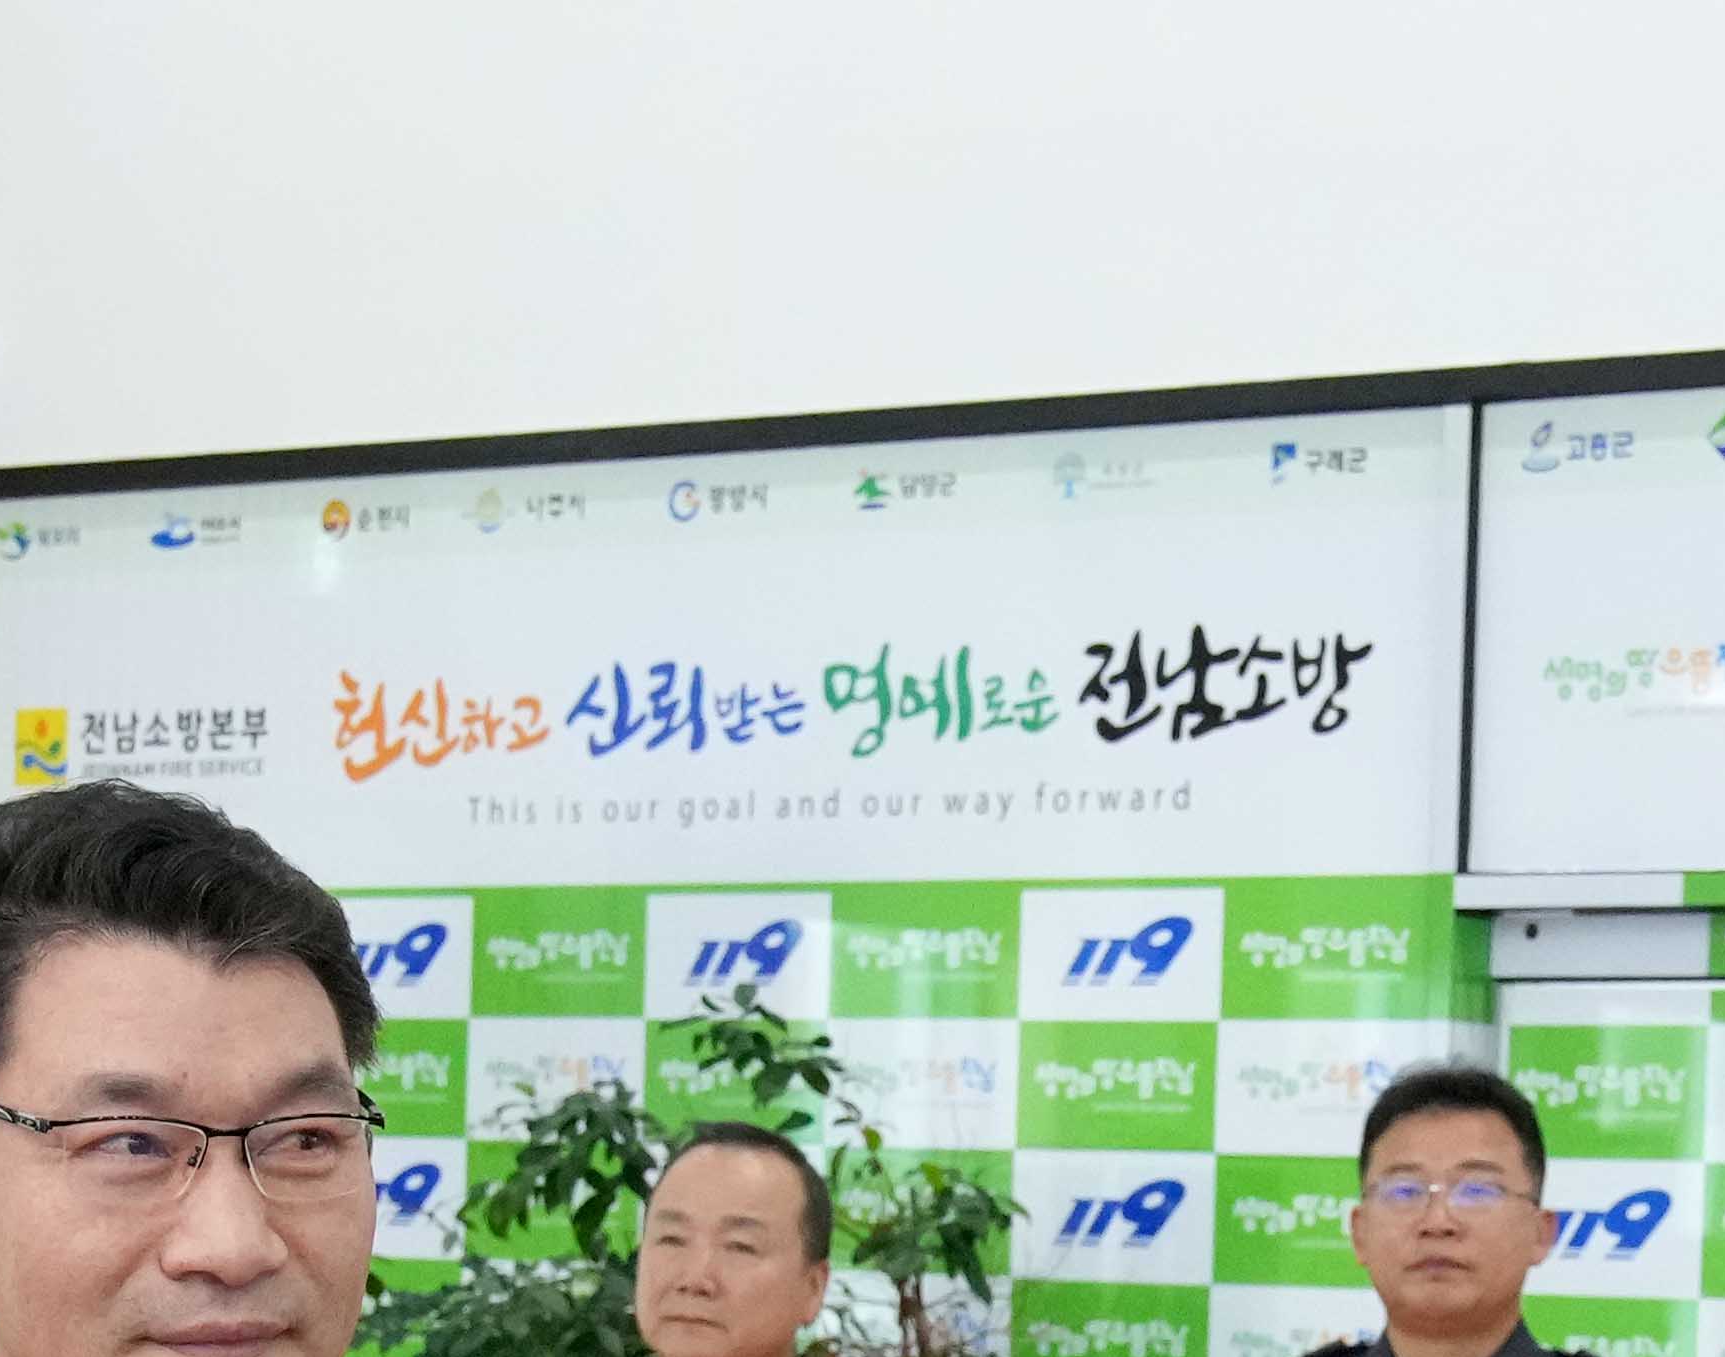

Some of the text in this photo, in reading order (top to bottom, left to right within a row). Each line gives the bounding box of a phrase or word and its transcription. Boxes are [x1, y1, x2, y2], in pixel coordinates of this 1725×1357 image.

[82, 707, 269, 755] 전남소방본부
[334, 625, 1373, 782] 헌신하고 신뢰받는 명예로운 전남소방
[468, 780, 1193, 830] This is our goal and our way forward
[685, 917, 803, 986] 119
[1061, 916, 1193, 986] 119
[1053, 1179, 1186, 1247] 119
